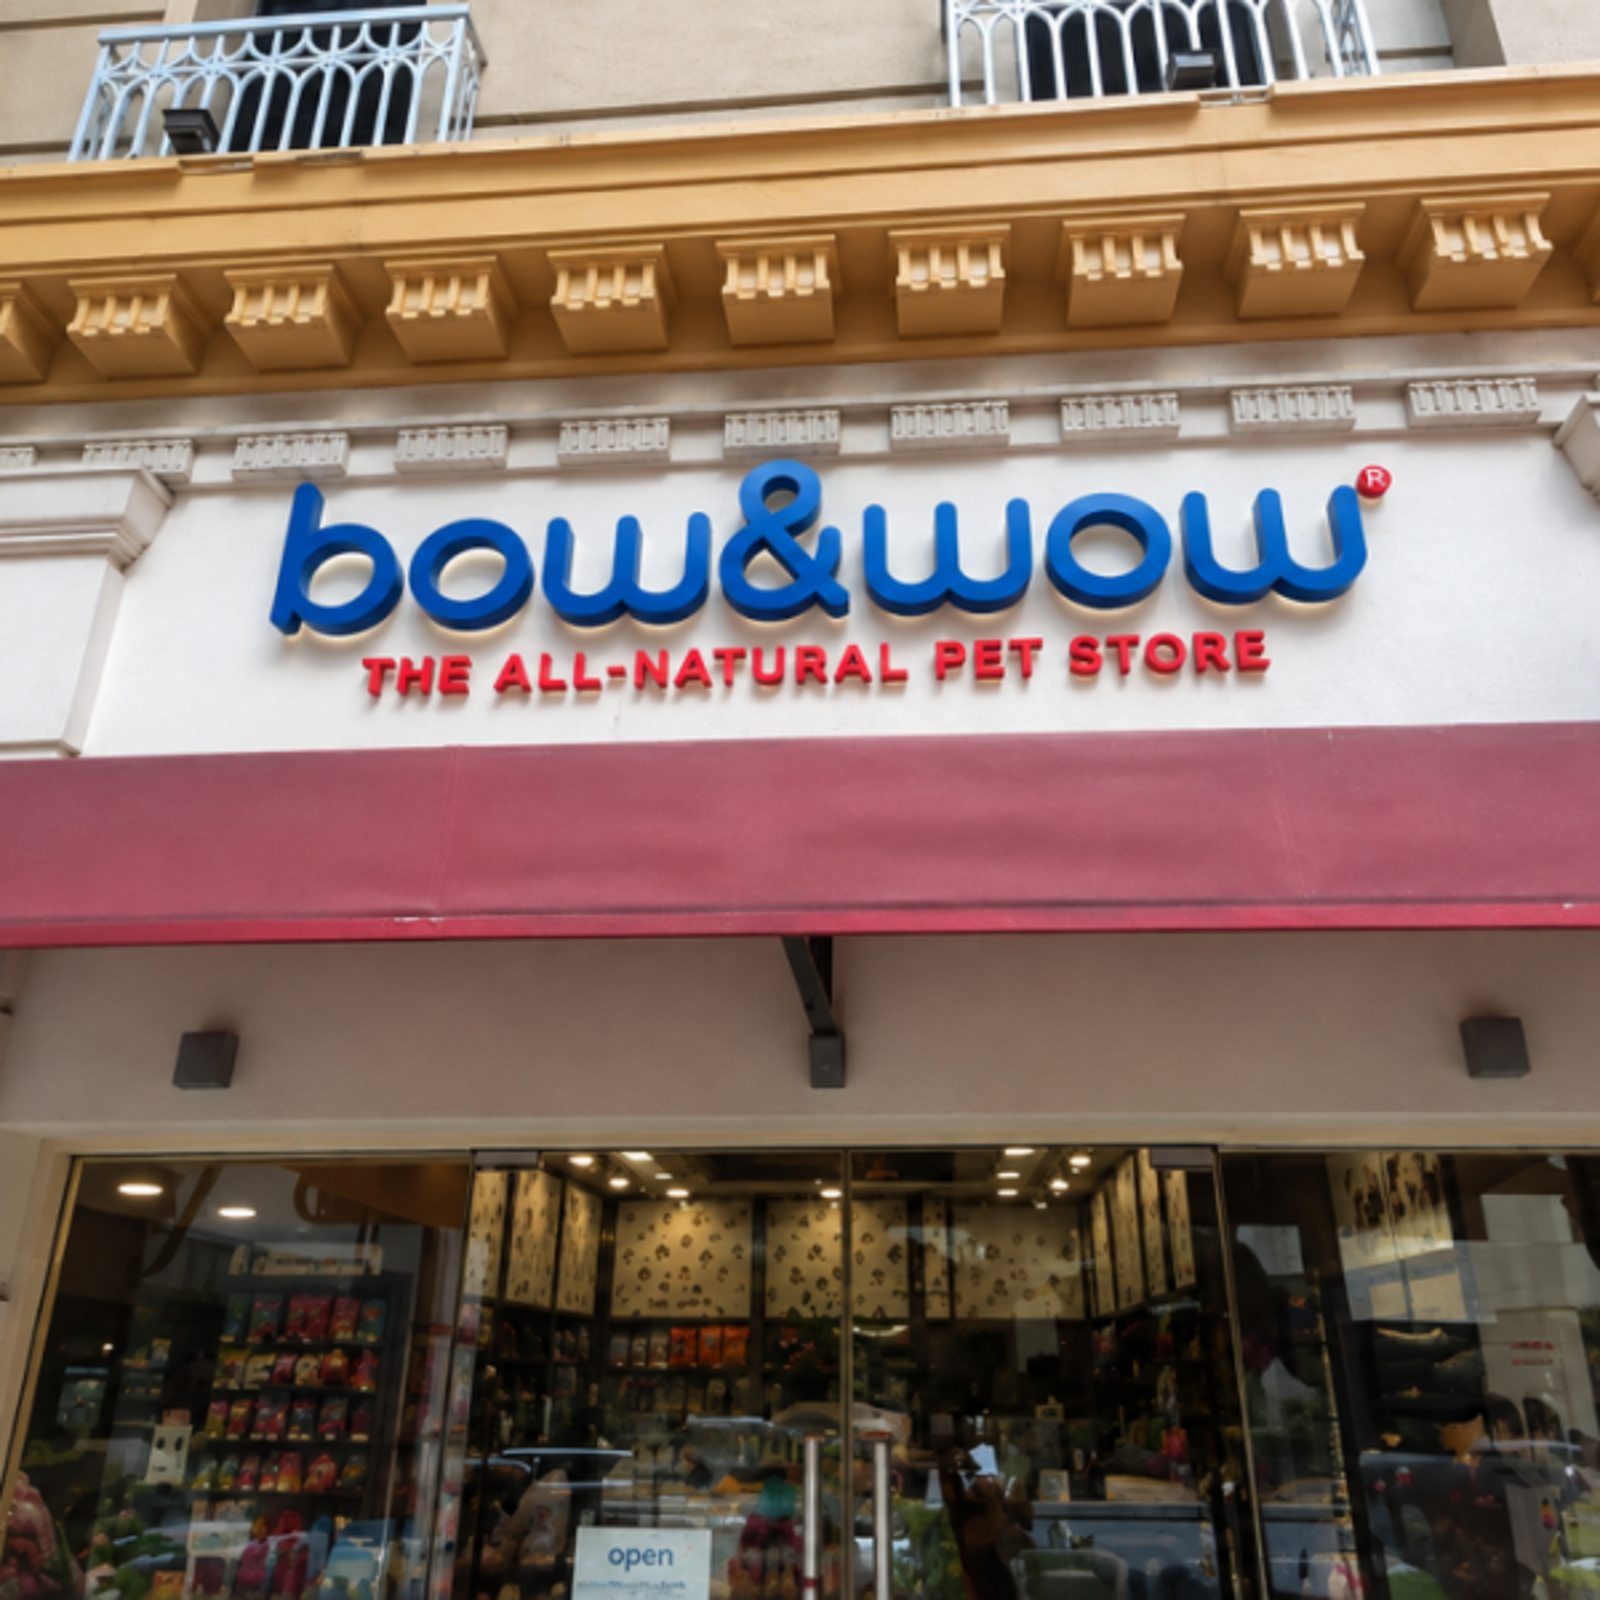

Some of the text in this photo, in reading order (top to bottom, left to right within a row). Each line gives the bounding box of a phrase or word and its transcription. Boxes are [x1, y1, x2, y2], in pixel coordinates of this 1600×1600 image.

[270, 460, 1368, 635] bow&wow
[363, 630, 1270, 697] THE ALL-NATURAL PET STORE
[607, 1546, 674, 1573] open
